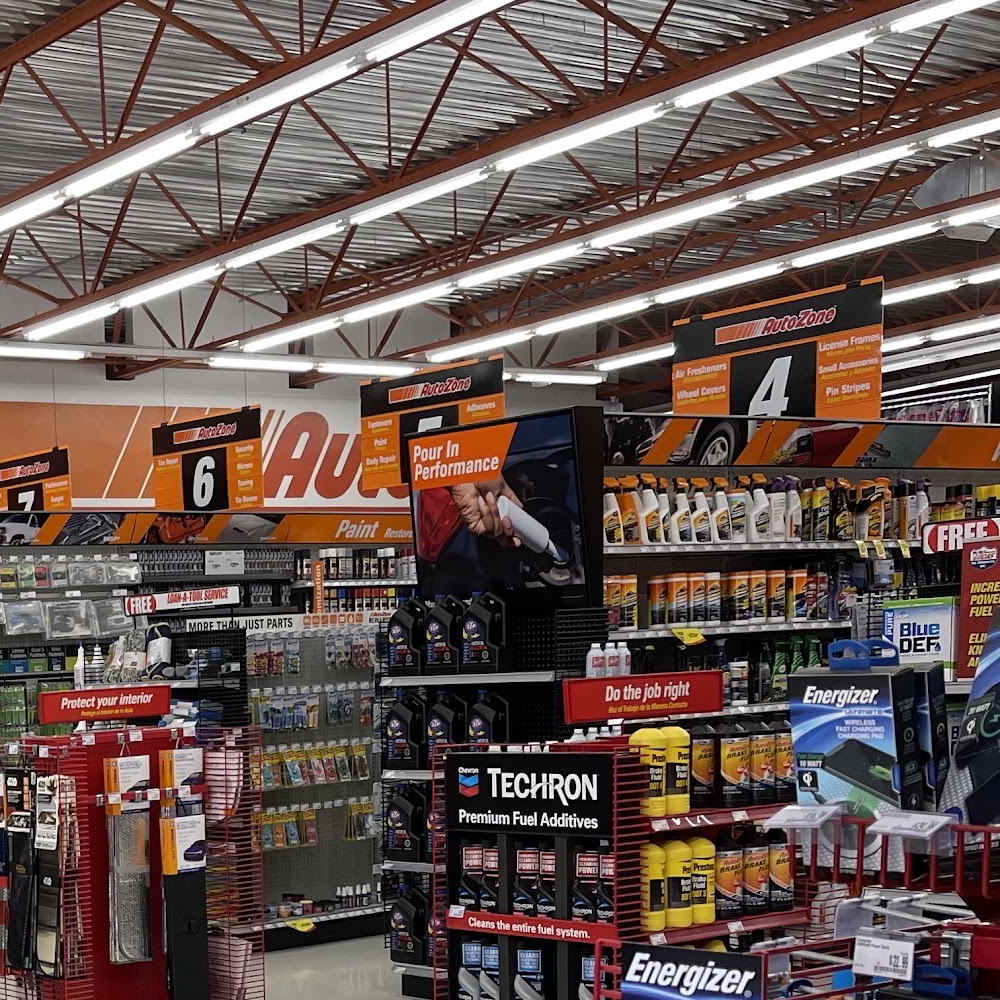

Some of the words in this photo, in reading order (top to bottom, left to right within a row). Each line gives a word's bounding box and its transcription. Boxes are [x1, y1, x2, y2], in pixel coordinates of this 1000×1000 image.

[761, 305, 837, 335] AutoZone
[818, 337, 849, 352] License
[850, 333, 881, 346] Frames
[675, 368, 686, 380] Air
[687, 363, 728, 377] Fresheners
[818, 362, 838, 375] Small
[838, 356, 879, 371] Accessories
[420, 375, 473, 398] AutoZone
[676, 387, 700, 400] Wheel
[701, 384, 726, 397] Covers
[748, 355, 793, 417] 4
[825, 385, 840, 397] Pin
[841, 381, 871, 395] Stripes
[466, 401, 497, 413] Adhesives
[198, 422, 237, 441] AutoZone
[413, 444, 443, 463] Pour
[445, 440, 460, 459] In
[414, 455, 500, 482] Performance
[193, 455, 216, 508] 6
[18, 490, 35, 511] 7
[335, 519, 380, 539] Paint
[937, 520, 989, 551] FREE
[130, 596, 152, 614] FREE
[167, 590, 203, 604] LOAN-A-TOOL
[204, 588, 229, 600] SERVICE
[969, 605, 993, 618] FUEL
[242, 619, 266, 631] JUST
[266, 617, 293, 629] PARTS
[886, 611, 895, 636] PURE
[899, 622, 940, 637] Blue
[899, 636, 940, 653] DEF
[61, 696, 95, 709] Protect
[96, 696, 119, 709] your
[120, 692, 153, 705] interior
[605, 685, 620, 702] Do
[623, 684, 642, 700] the
[642, 683, 662, 703] job
[663, 680, 691, 701] right
[803, 686, 879, 706] Energizer
[458, 766, 479, 774] Chevron
[487, 768, 599, 806] TECHRON
[458, 809, 510, 827] Premium
[513, 811, 538, 827] Fuel
[540, 812, 599, 829] Additives
[468, 917, 495, 930] Cleans
[496, 919, 511, 931] the
[512, 921, 537, 934] entire
[537, 924, 554, 935] fuel
[556, 928, 590, 940] system.
[625, 951, 756, 997] Energizer
